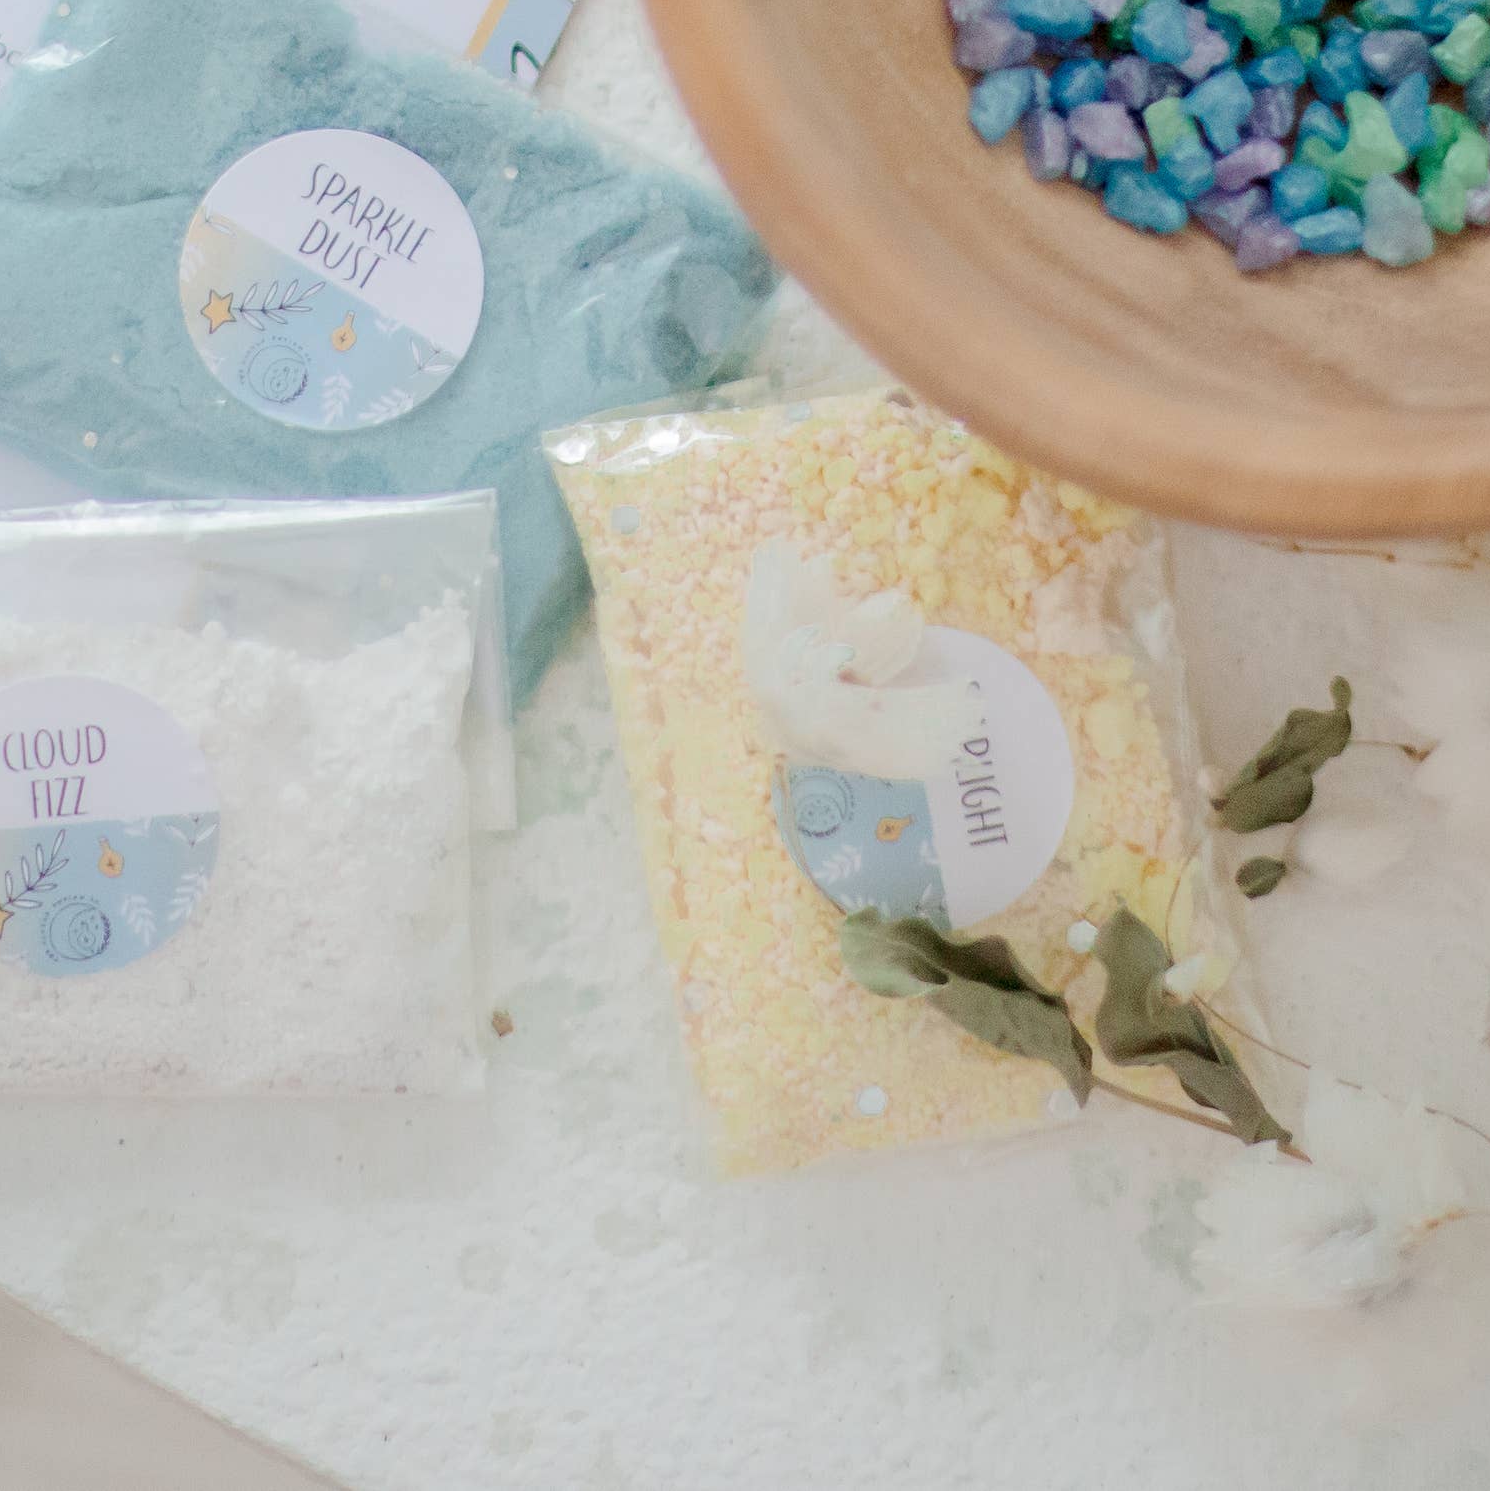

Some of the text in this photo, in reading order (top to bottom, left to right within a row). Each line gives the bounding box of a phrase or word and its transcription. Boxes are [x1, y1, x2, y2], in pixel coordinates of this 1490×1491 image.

[300, 162, 436, 265] SPARKLE
[297, 218, 388, 290] DUST
[2, 724, 107, 773] CLOUD
[30, 775, 90, 820] FIZZ
